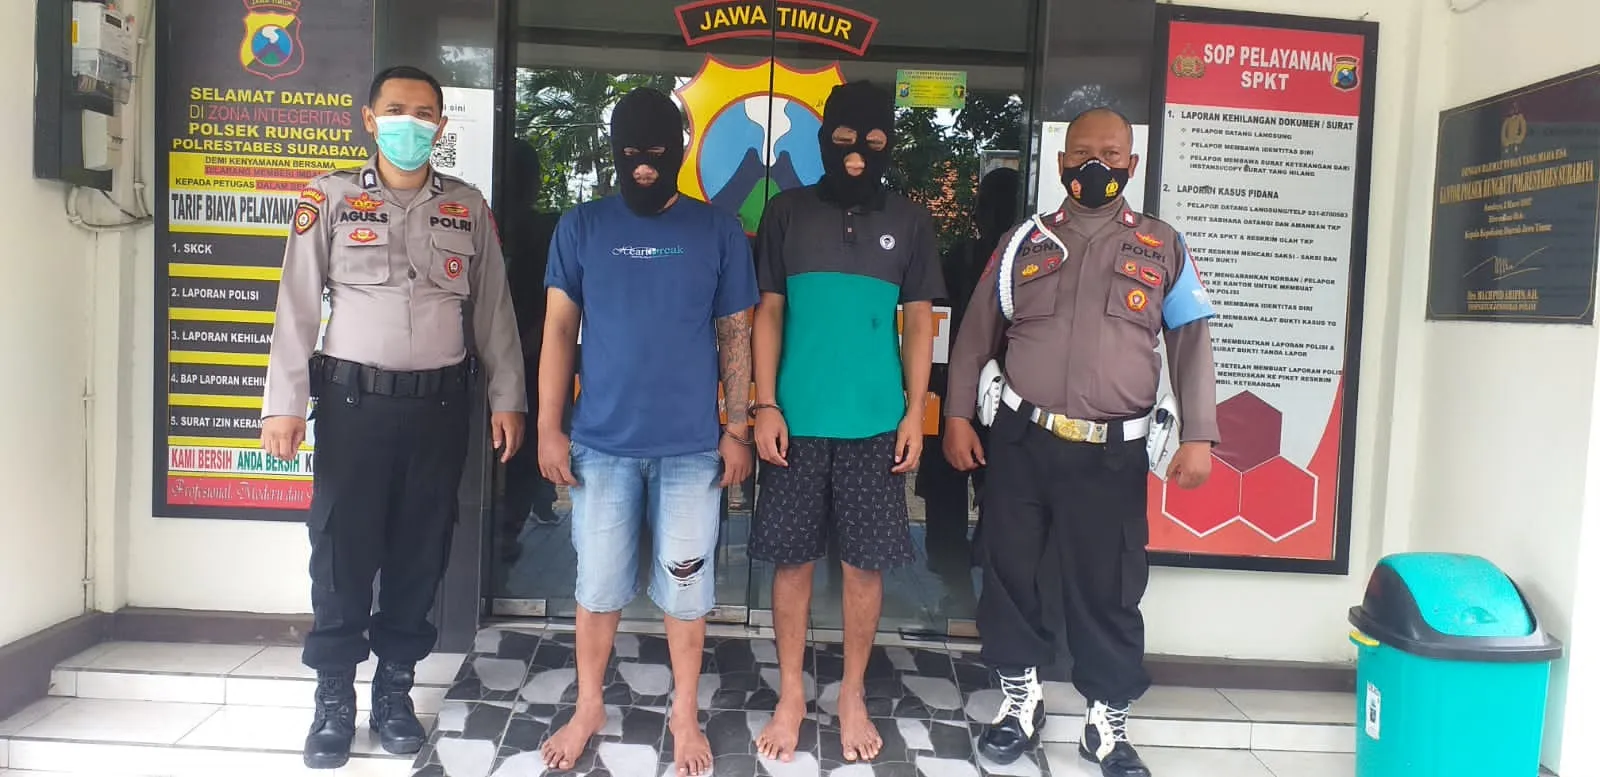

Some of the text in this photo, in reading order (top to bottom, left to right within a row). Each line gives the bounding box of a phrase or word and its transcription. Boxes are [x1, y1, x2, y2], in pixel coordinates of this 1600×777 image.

[700, 5, 852, 40] JAWA TIMUR
[1204, 43, 1334, 72] SOP PELAYANAN
[1241, 71, 1290, 91] SPKT
[190, 87, 353, 107] SELAMAT DATANG
[190, 104, 352, 126] DI ZONA INTEGERITAS
[1168, 110, 1175, 118] 1.
[1181, 111, 1220, 121] LAPORAN
[1222, 113, 1277, 125] KEHILANGAN
[1279, 118, 1321, 128] DOKUMEN
[1326, 121, 1354, 130] SURAT
[189, 122, 353, 142] POLSEK RUNGKUT
[1254, 131, 1292, 140] LANGSUNG
[172, 138, 369, 157] POLRESTABES SURABAYA
[1224, 143, 1260, 152] MEMBAWA
[1262, 147, 1298, 155] IDENTITAS
[205, 156, 336, 169] DEMI KENYAMANAN BERSAMA
[1223, 157, 1259, 165] MEMBAWA
[1261, 159, 1284, 167] SURAT
[1285, 161, 1332, 170] KETERANGAN
[175, 177, 212, 187] KEPADA
[213, 179, 255, 189] PETUGAS
[1163, 184, 1279, 199] 2. LAPORAN KASUS PIDANA
[171, 193, 299, 224] TARIF BIAYA PELAYANA
[340, 211, 388, 223] AGUS.S
[1209, 217, 1242, 225] SABHARA
[1291, 222, 1326, 230] AMANKAN
[430, 216, 472, 232] POLRI
[172, 243, 212, 254] 1. SKCK
[1120, 243, 1166, 263] POLRI
[1241, 250, 1273, 258] MENCARI
[1215, 272, 1269, 281] MENGARAHKAN
[171, 287, 259, 300] 2. LAPORAN POLISI
[1261, 303, 1297, 311] IDENTITAS
[171, 331, 273, 343] 3. LAPORAN KEHILAN
[1222, 338, 1270, 347] MEMBUATKAN
[1253, 364, 1287, 372] MEMBUAT
[170, 374, 266, 386] 4. BAP LAPORAN KEHIL
[1234, 380, 1280, 388] KETERANGAN
[170, 416, 264, 429] 5. SURAT IZIN KERAM
[171, 449, 195, 468] KAMI
[198, 449, 232, 470] BERSIH
[237, 451, 263, 471] ANDA
